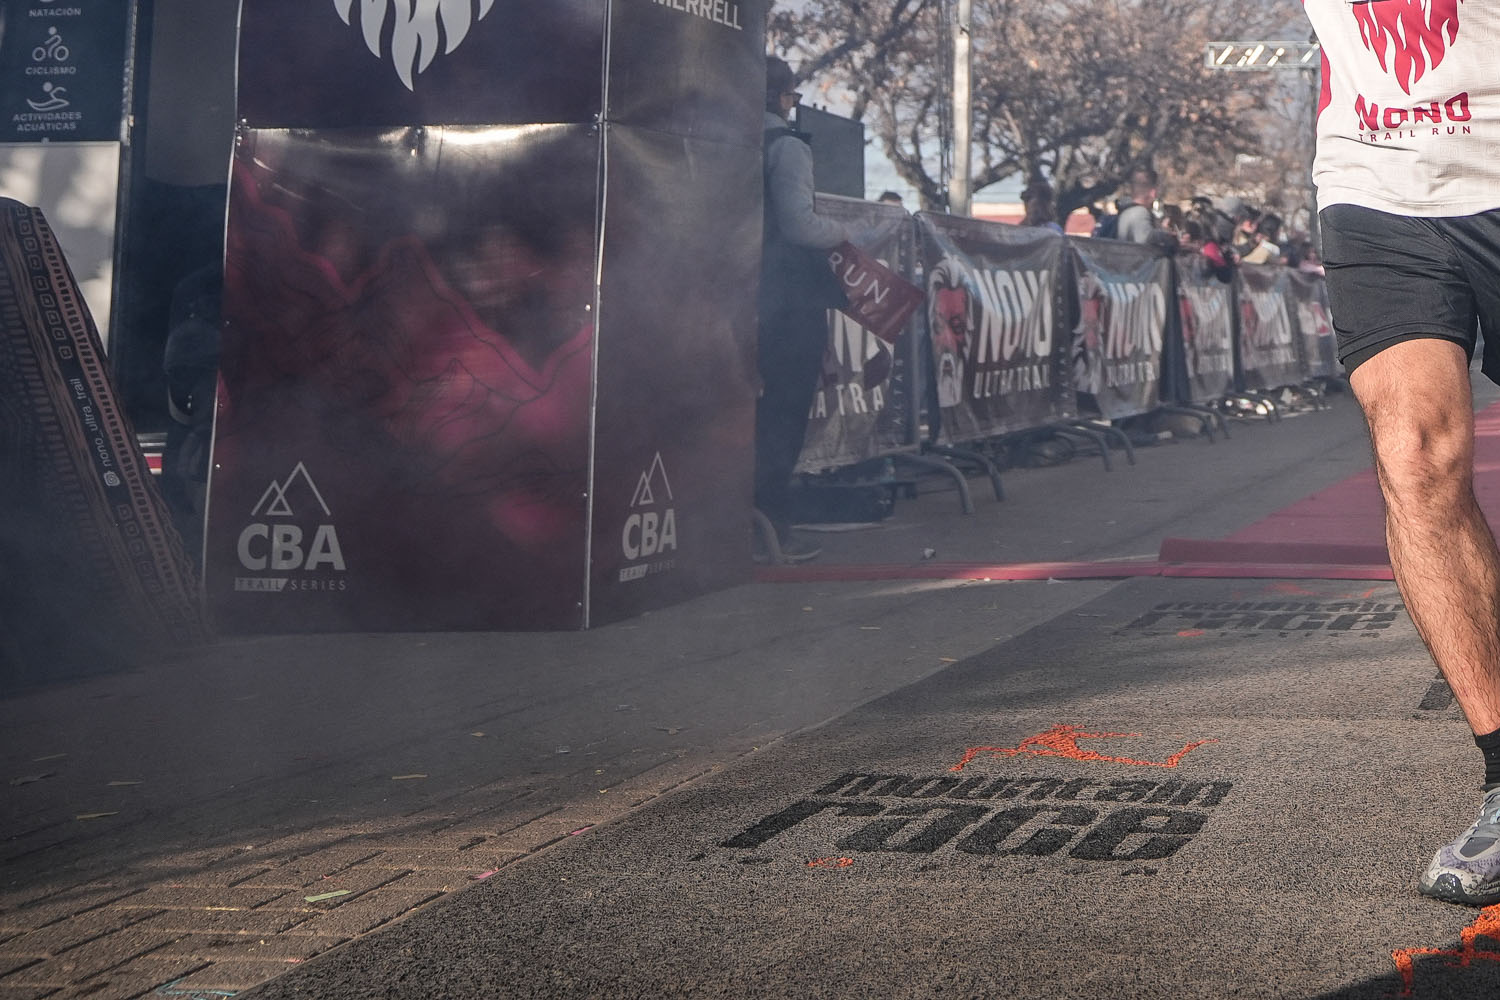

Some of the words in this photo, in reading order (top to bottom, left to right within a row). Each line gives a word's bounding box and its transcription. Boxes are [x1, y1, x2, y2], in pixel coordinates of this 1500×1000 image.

[29, 7, 82, 18] NATACIÓN
[25, 66, 76, 75] CICLISMO
[13, 111, 82, 122] ACTIVIDADES
[1355, 92, 1472, 131] NONO
[1359, 129, 1415, 142] TRAIL
[1432, 126, 1471, 135] RUN
[828, 252, 890, 304] RUN
[622, 508, 677, 560] CBA
[237, 523, 346, 571] CBA
[291, 580, 346, 591] SERIES
